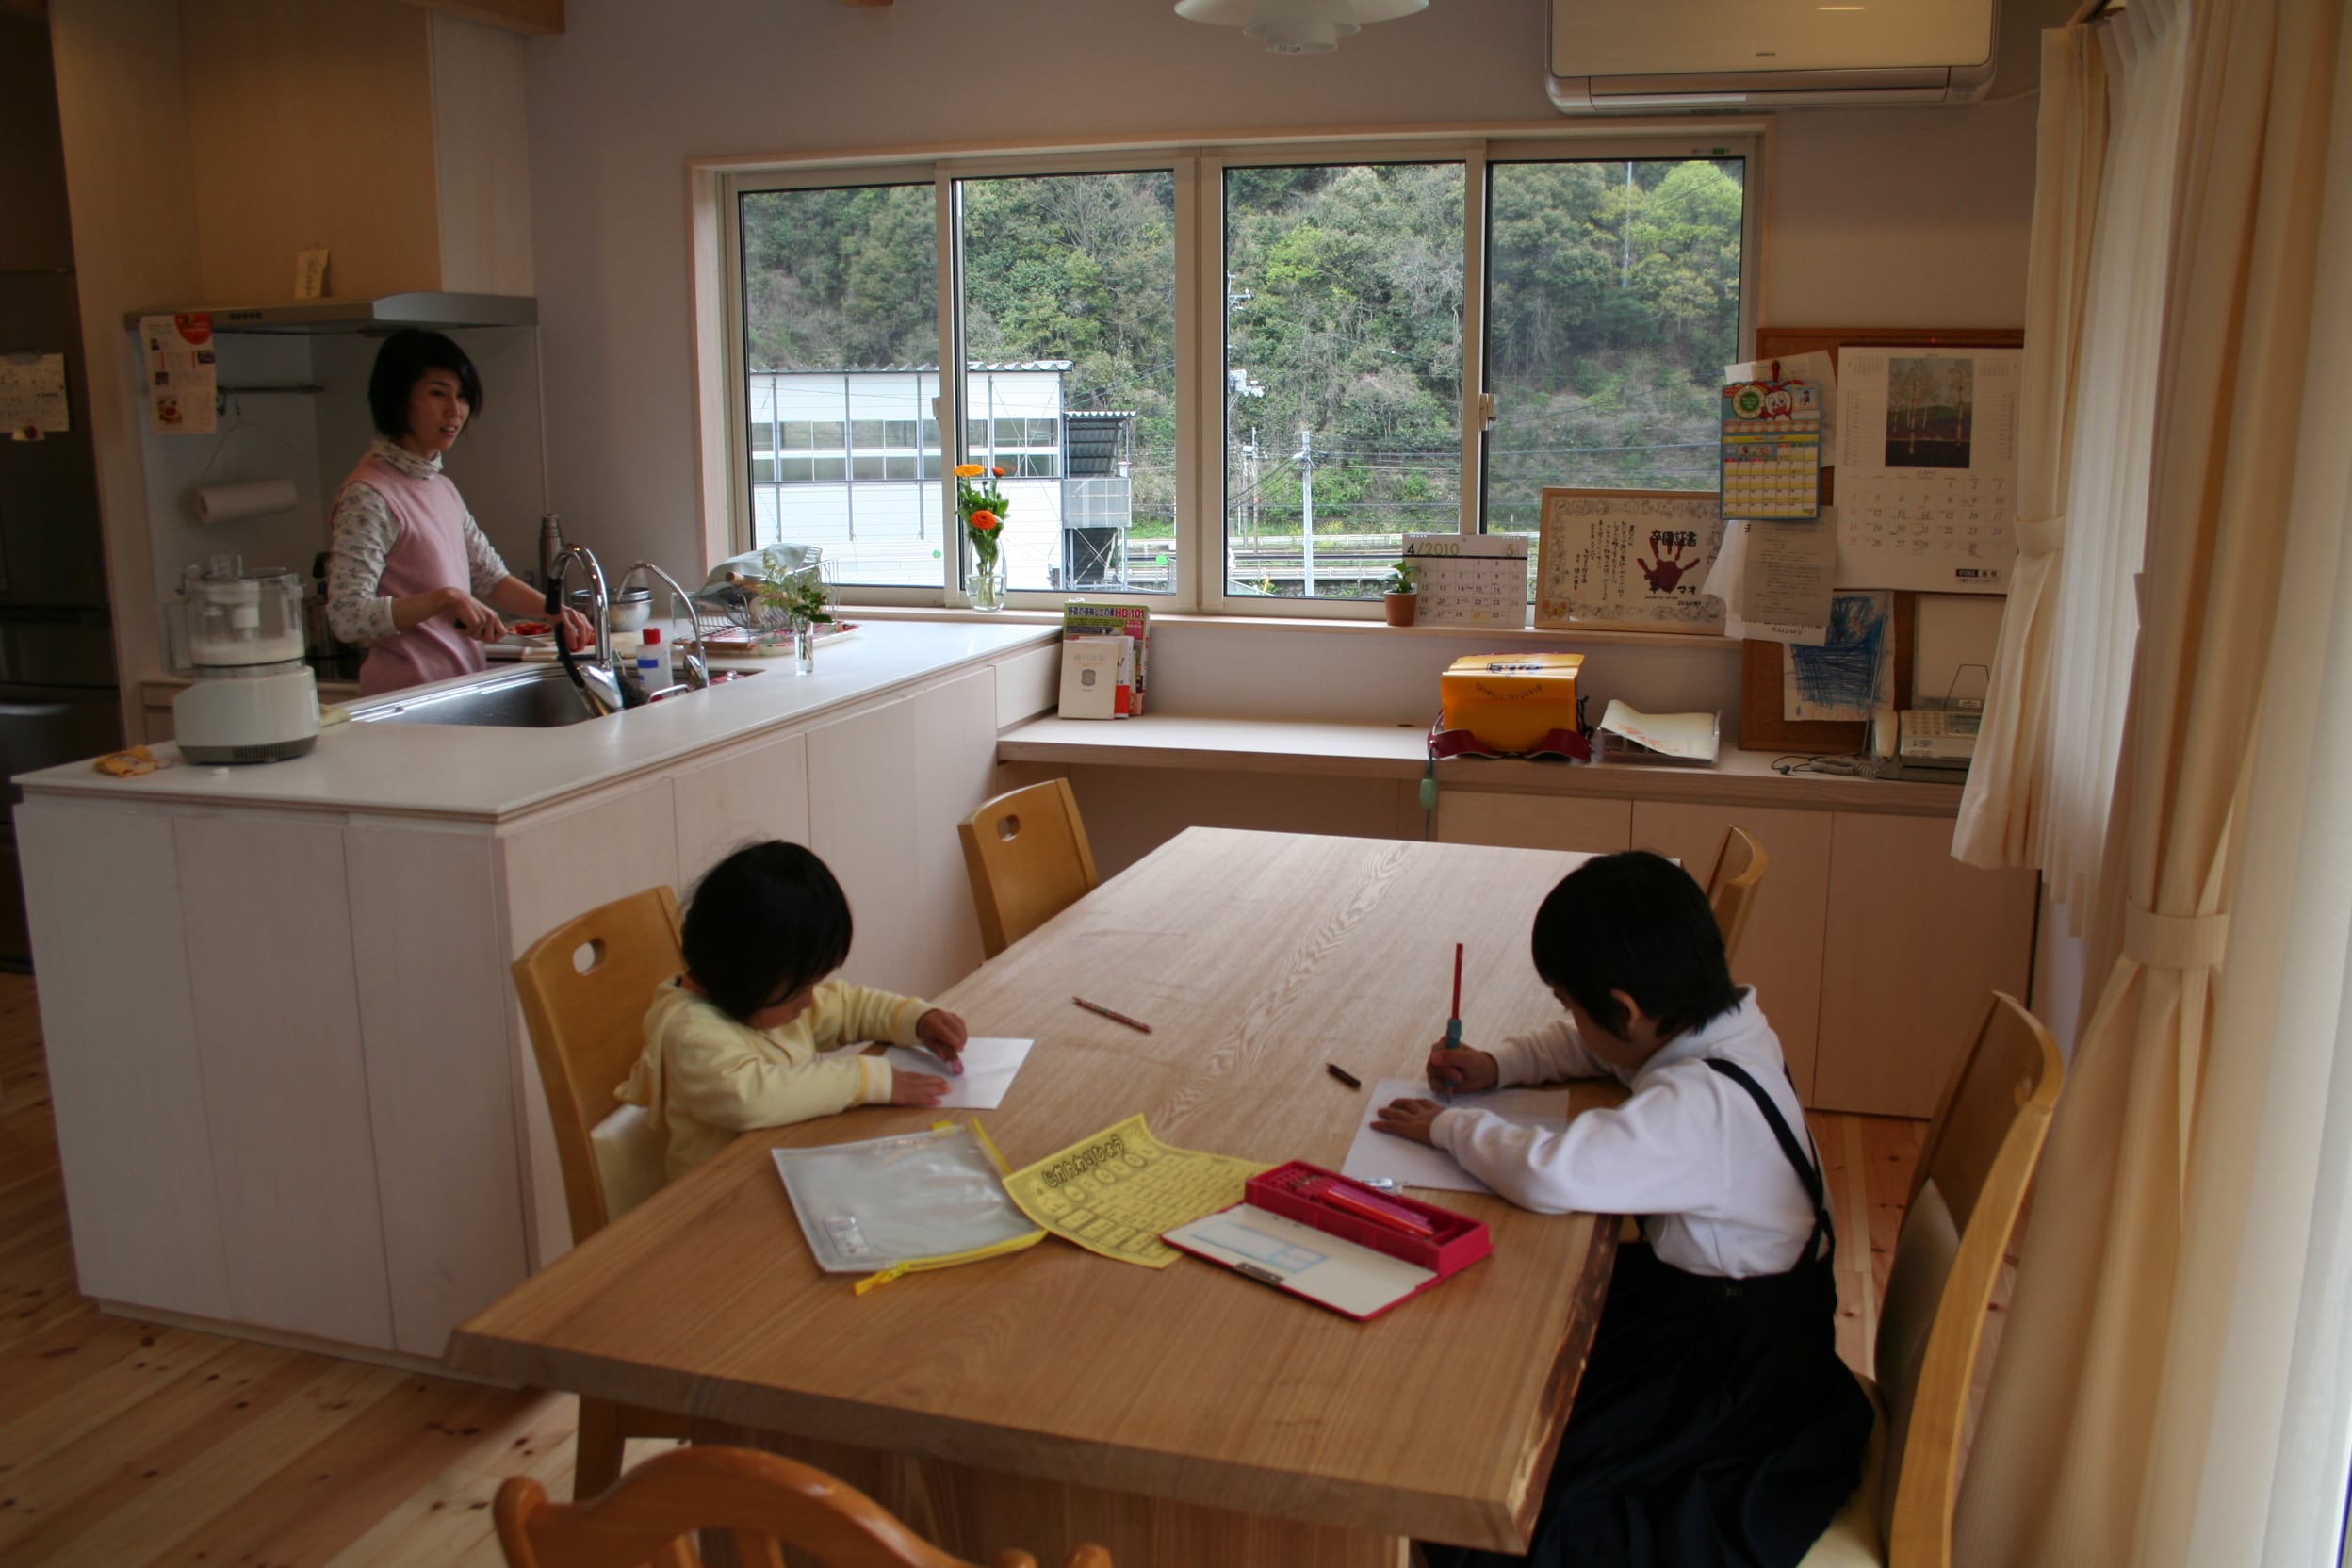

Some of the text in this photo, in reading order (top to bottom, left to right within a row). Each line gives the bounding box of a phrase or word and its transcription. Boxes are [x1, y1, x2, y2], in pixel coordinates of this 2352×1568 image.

[1115, 608, 1145, 619] HB-101
[1041, 1134, 1125, 1188] じかんわりひょう
